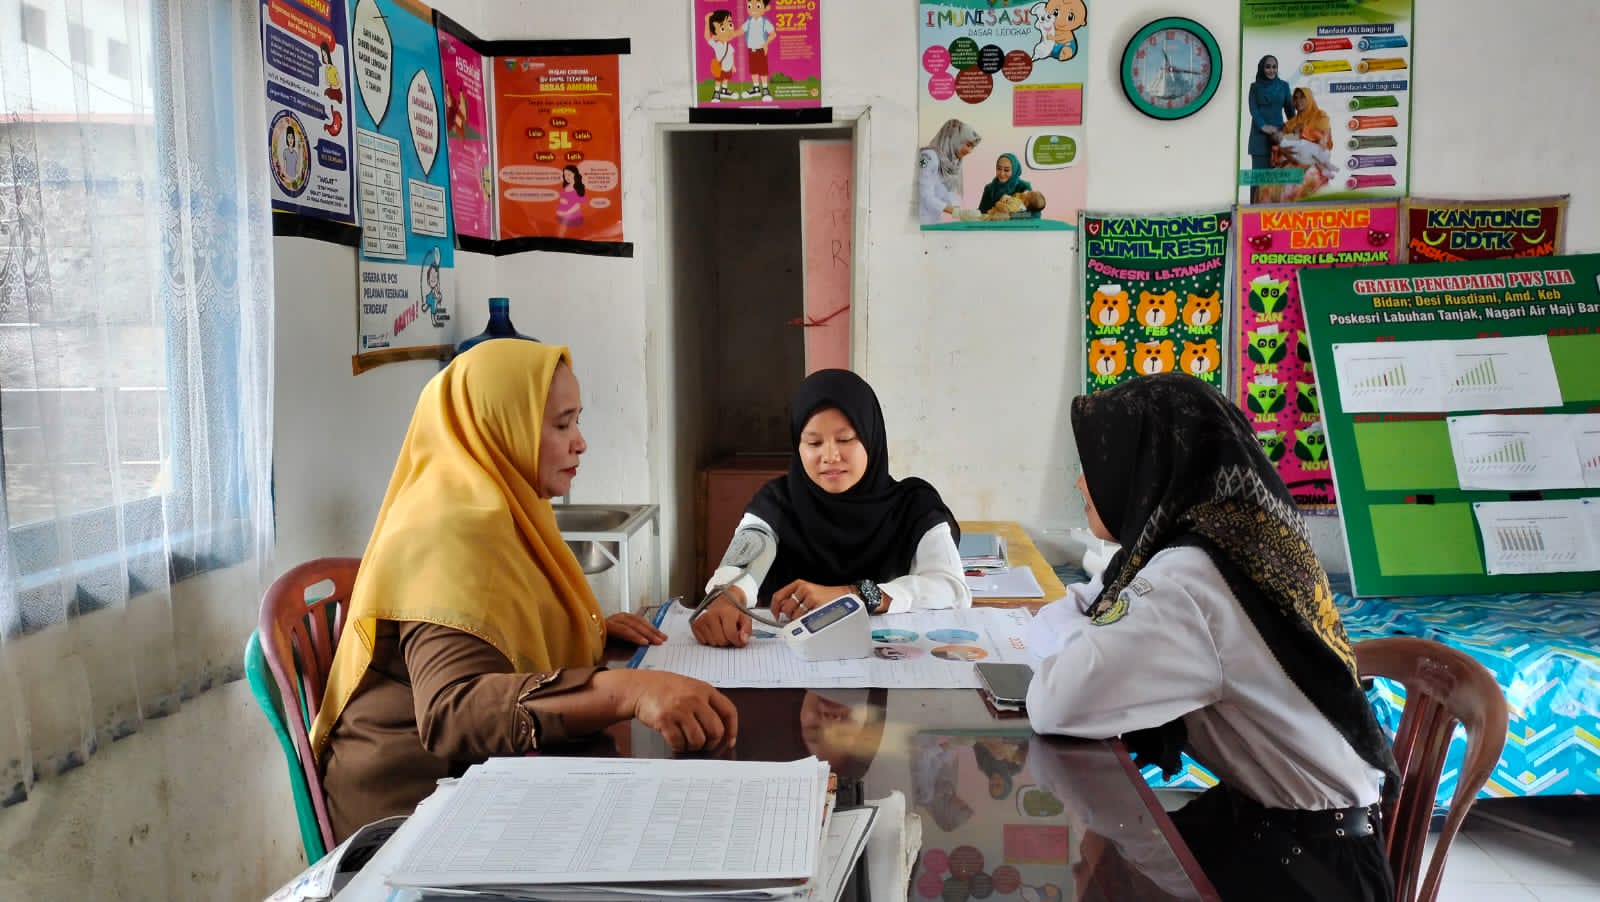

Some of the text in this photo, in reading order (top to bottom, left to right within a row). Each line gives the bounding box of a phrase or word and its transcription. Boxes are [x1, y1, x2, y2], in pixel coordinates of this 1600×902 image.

[926, 8, 1031, 28] IMUNISASI
[968, 29, 993, 37] DASAR
[548, 131, 572, 149] 5L
[1102, 215, 1217, 238] KANTONG
[1261, 208, 1370, 231] KANTONG
[1427, 208, 1541, 229] KANTONG
[1088, 236, 1224, 259] BUMIL RESTI
[1291, 229, 1340, 249] BAYI
[1450, 231, 1517, 250] DDTK
[1251, 250, 1389, 265] POSKESRI LB.TANJAK
[363, 271, 380, 283] SEGERA
[1087, 257, 1222, 281] POSKESRI LB.TANJAK
[1354, 269, 1576, 294] GRAFIK PENCAPAIAN PWS KIA
[1373, 289, 1561, 308] Bidan; Desi Rusdiani, Amd. Keb
[363, 303, 388, 314] TERDEKAT
[1256, 312, 1282, 323] JAN
[1329, 302, 1600, 325] Poskesri Labuhan Tanjak, Nagari Air Haji Bar
[1095, 325, 1213, 336] JAN FEB MAR
[1095, 374, 1117, 385] APR
[1254, 413, 1278, 423] JUL
[1301, 460, 1329, 471] NOV
